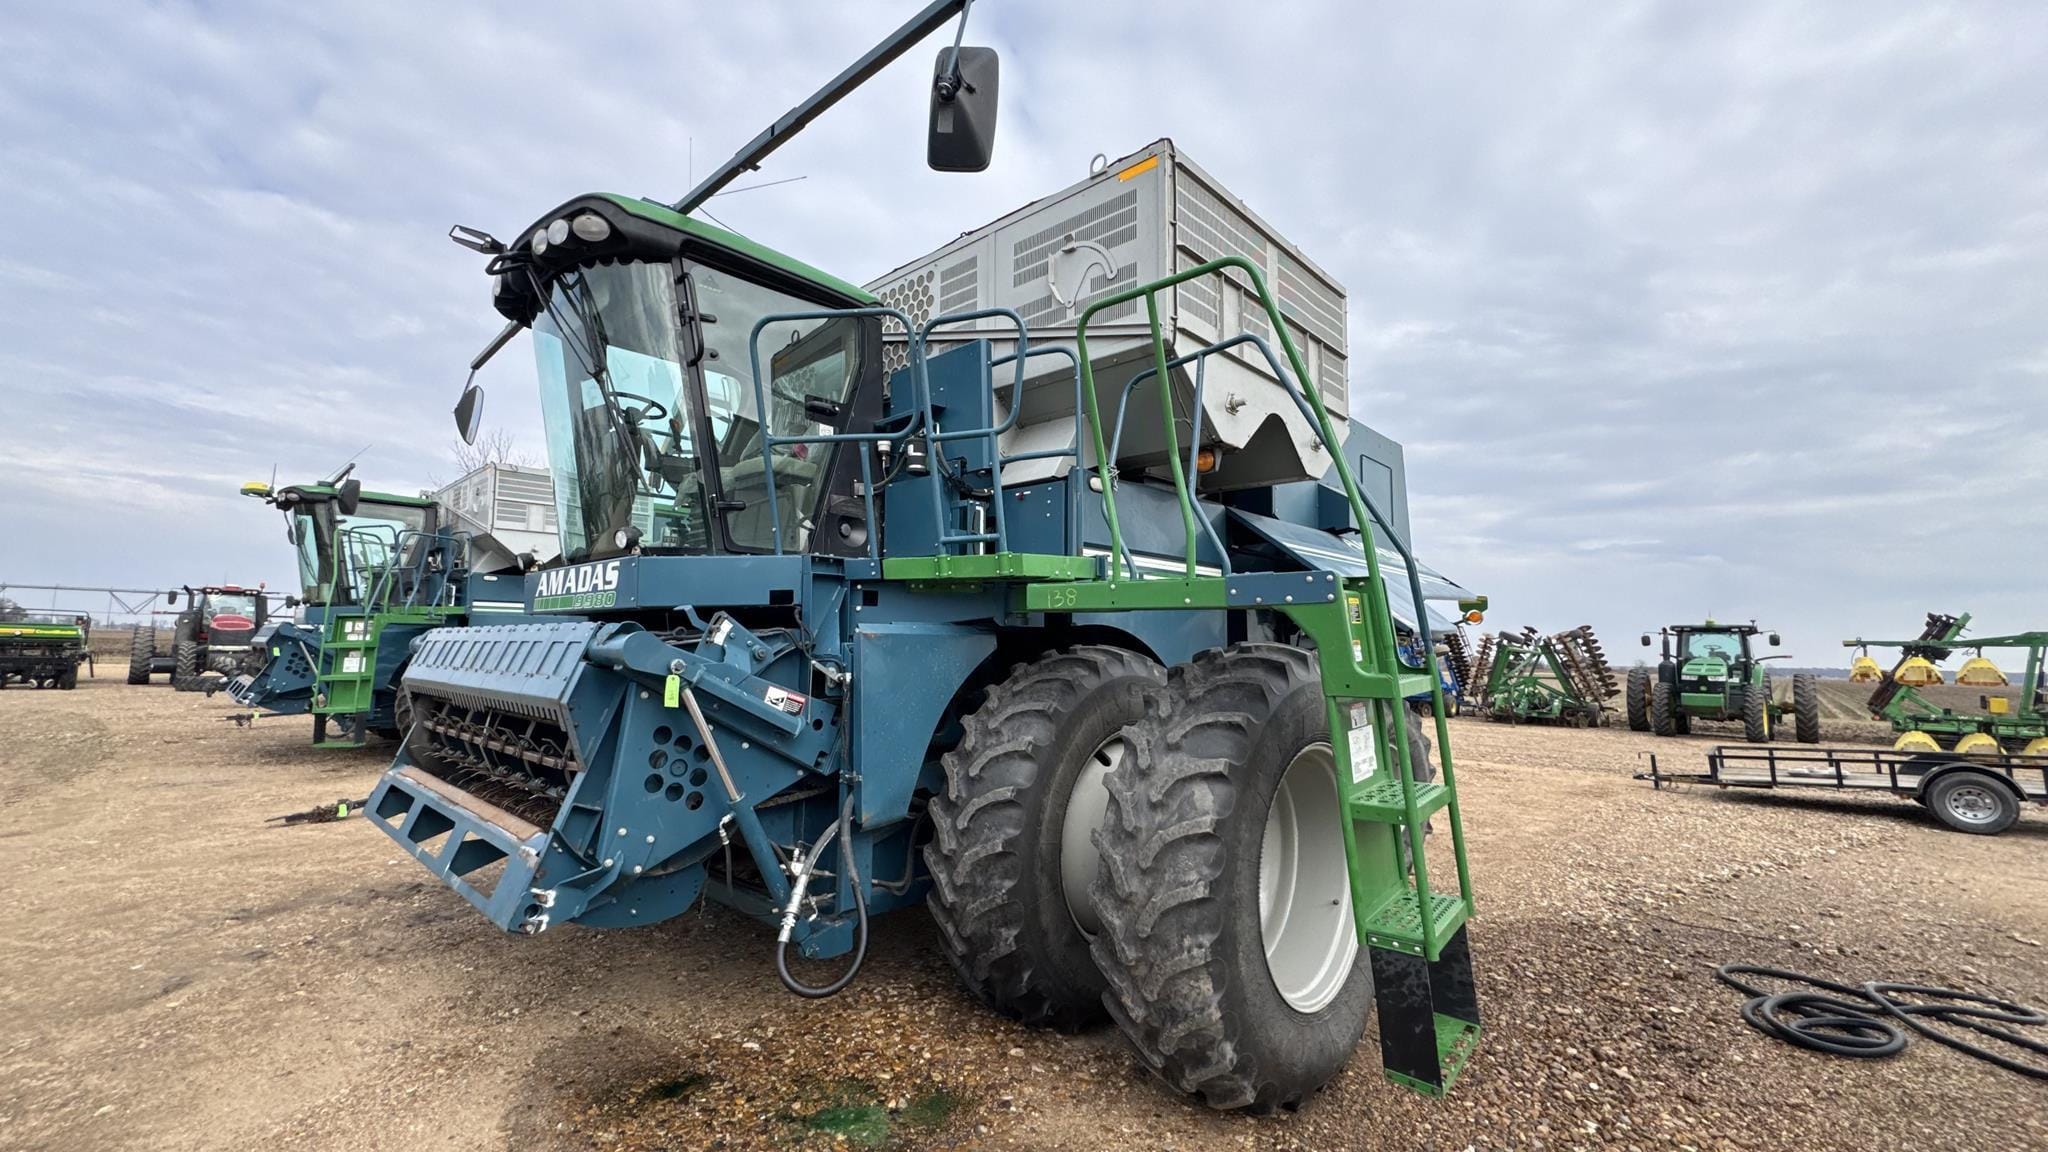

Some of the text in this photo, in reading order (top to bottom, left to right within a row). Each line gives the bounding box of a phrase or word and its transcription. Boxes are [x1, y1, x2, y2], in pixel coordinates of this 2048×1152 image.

[535, 561, 620, 597] AMADAS
[573, 591, 616, 609] 9980
[1047, 588, 1077, 608] 138
